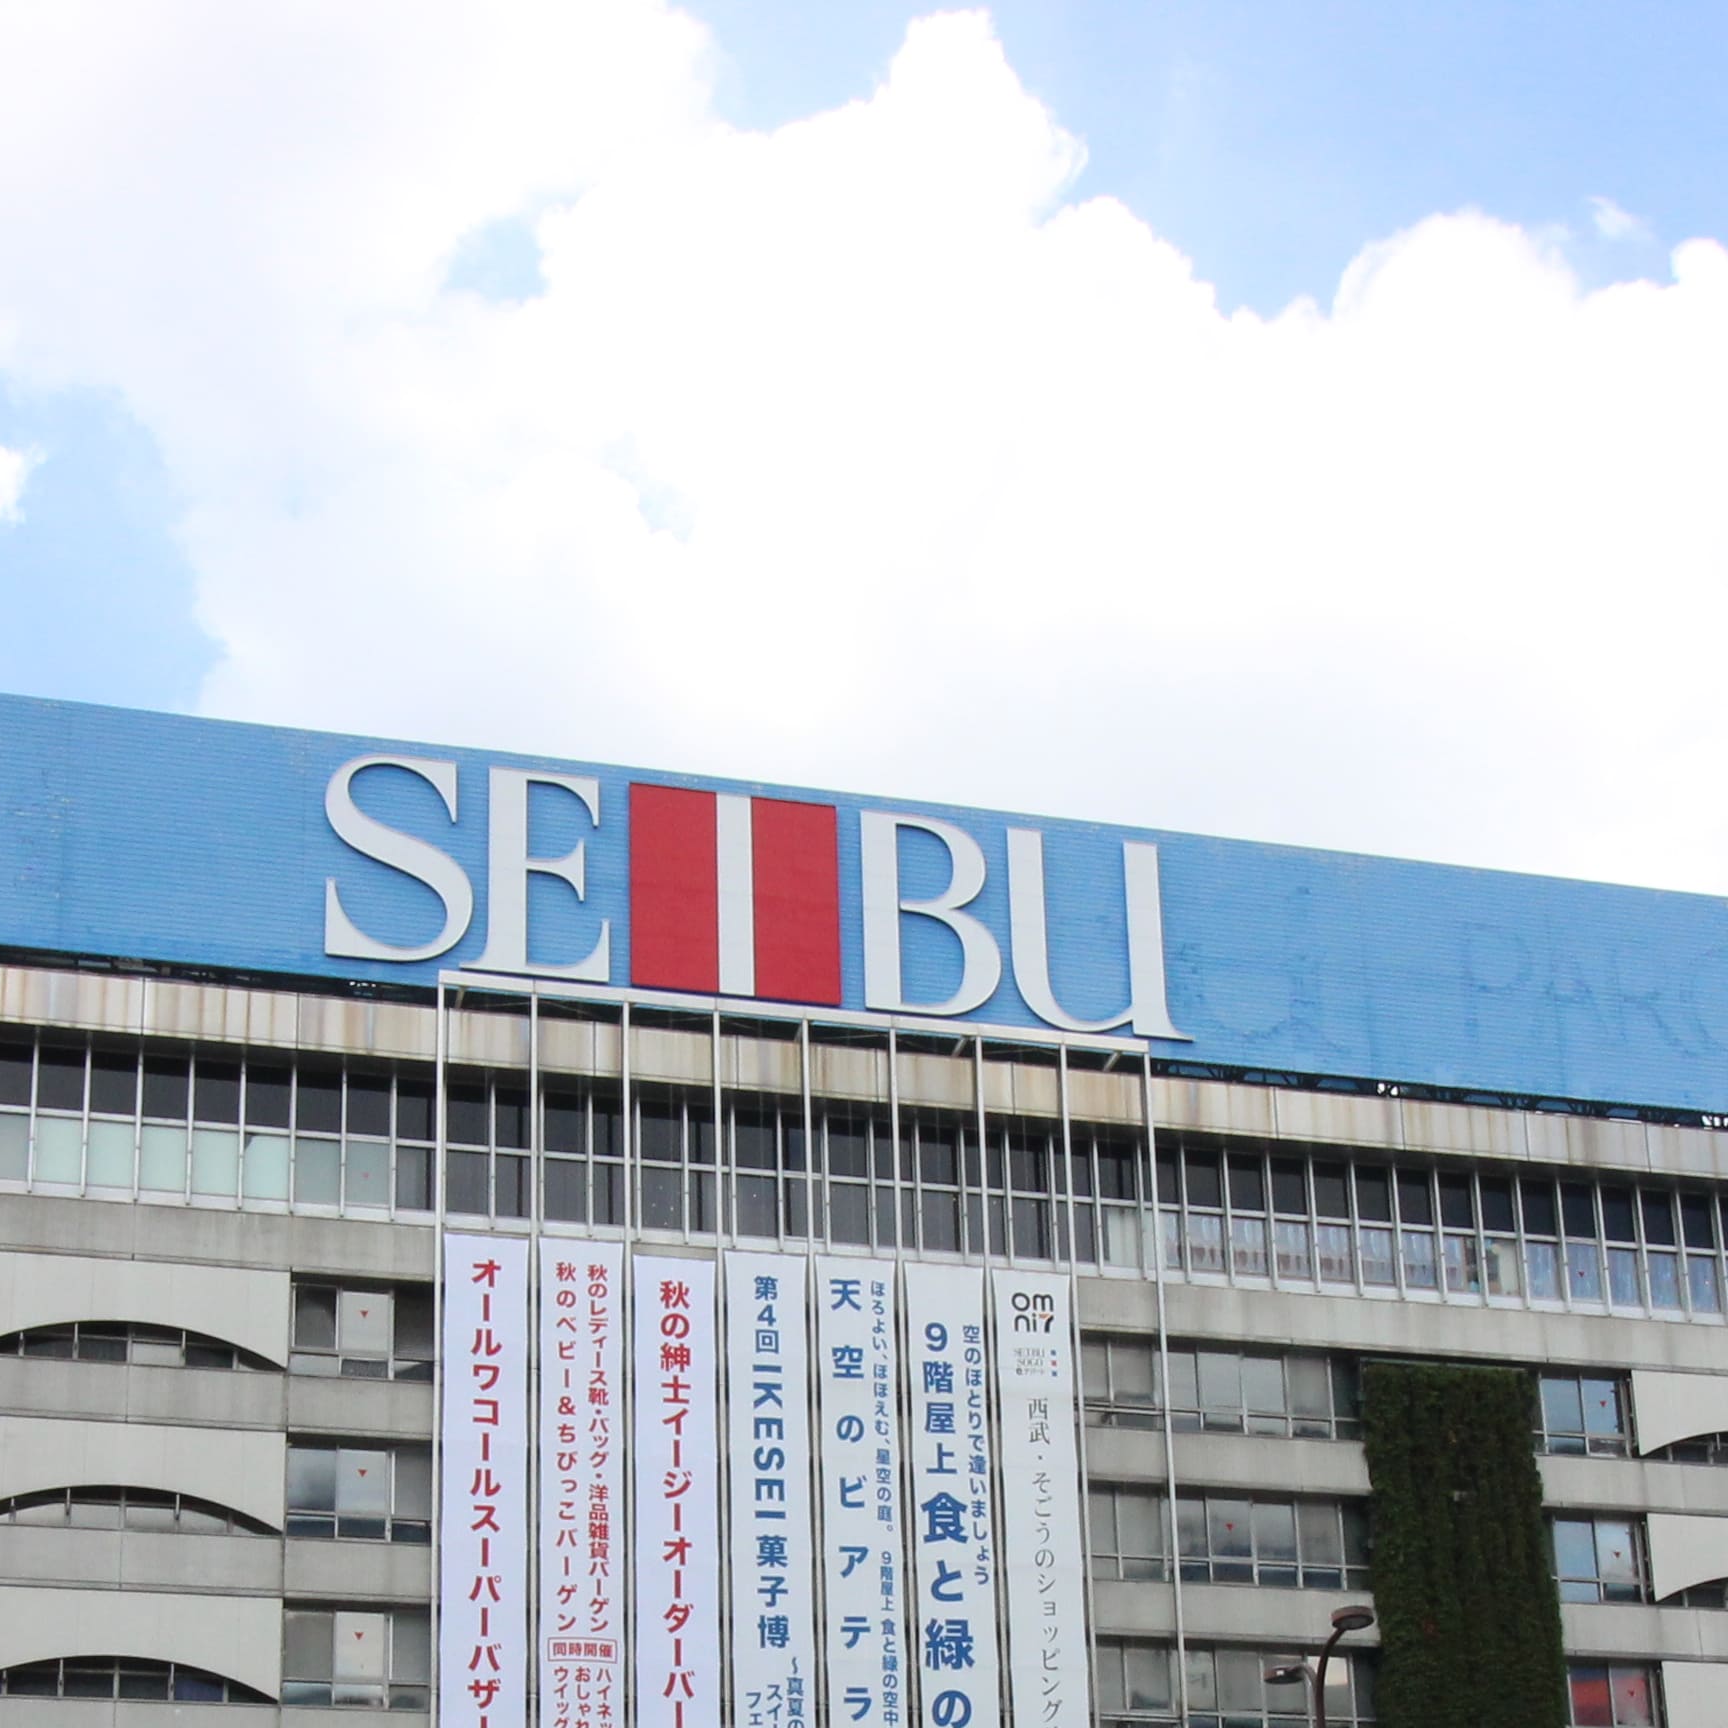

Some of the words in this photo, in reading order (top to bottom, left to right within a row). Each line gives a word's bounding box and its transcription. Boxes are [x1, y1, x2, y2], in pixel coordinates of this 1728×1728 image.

[324, 753, 1194, 1043] SEIBU
[555, 1261, 578, 1632] 秋のベビー&ちびっこバーゲン
[587, 1264, 611, 1632] 秋のレディース靴・バッグ・洋品雑貨バーゲン
[963, 1324, 990, 1586] 空のほとりで逢いましょう
